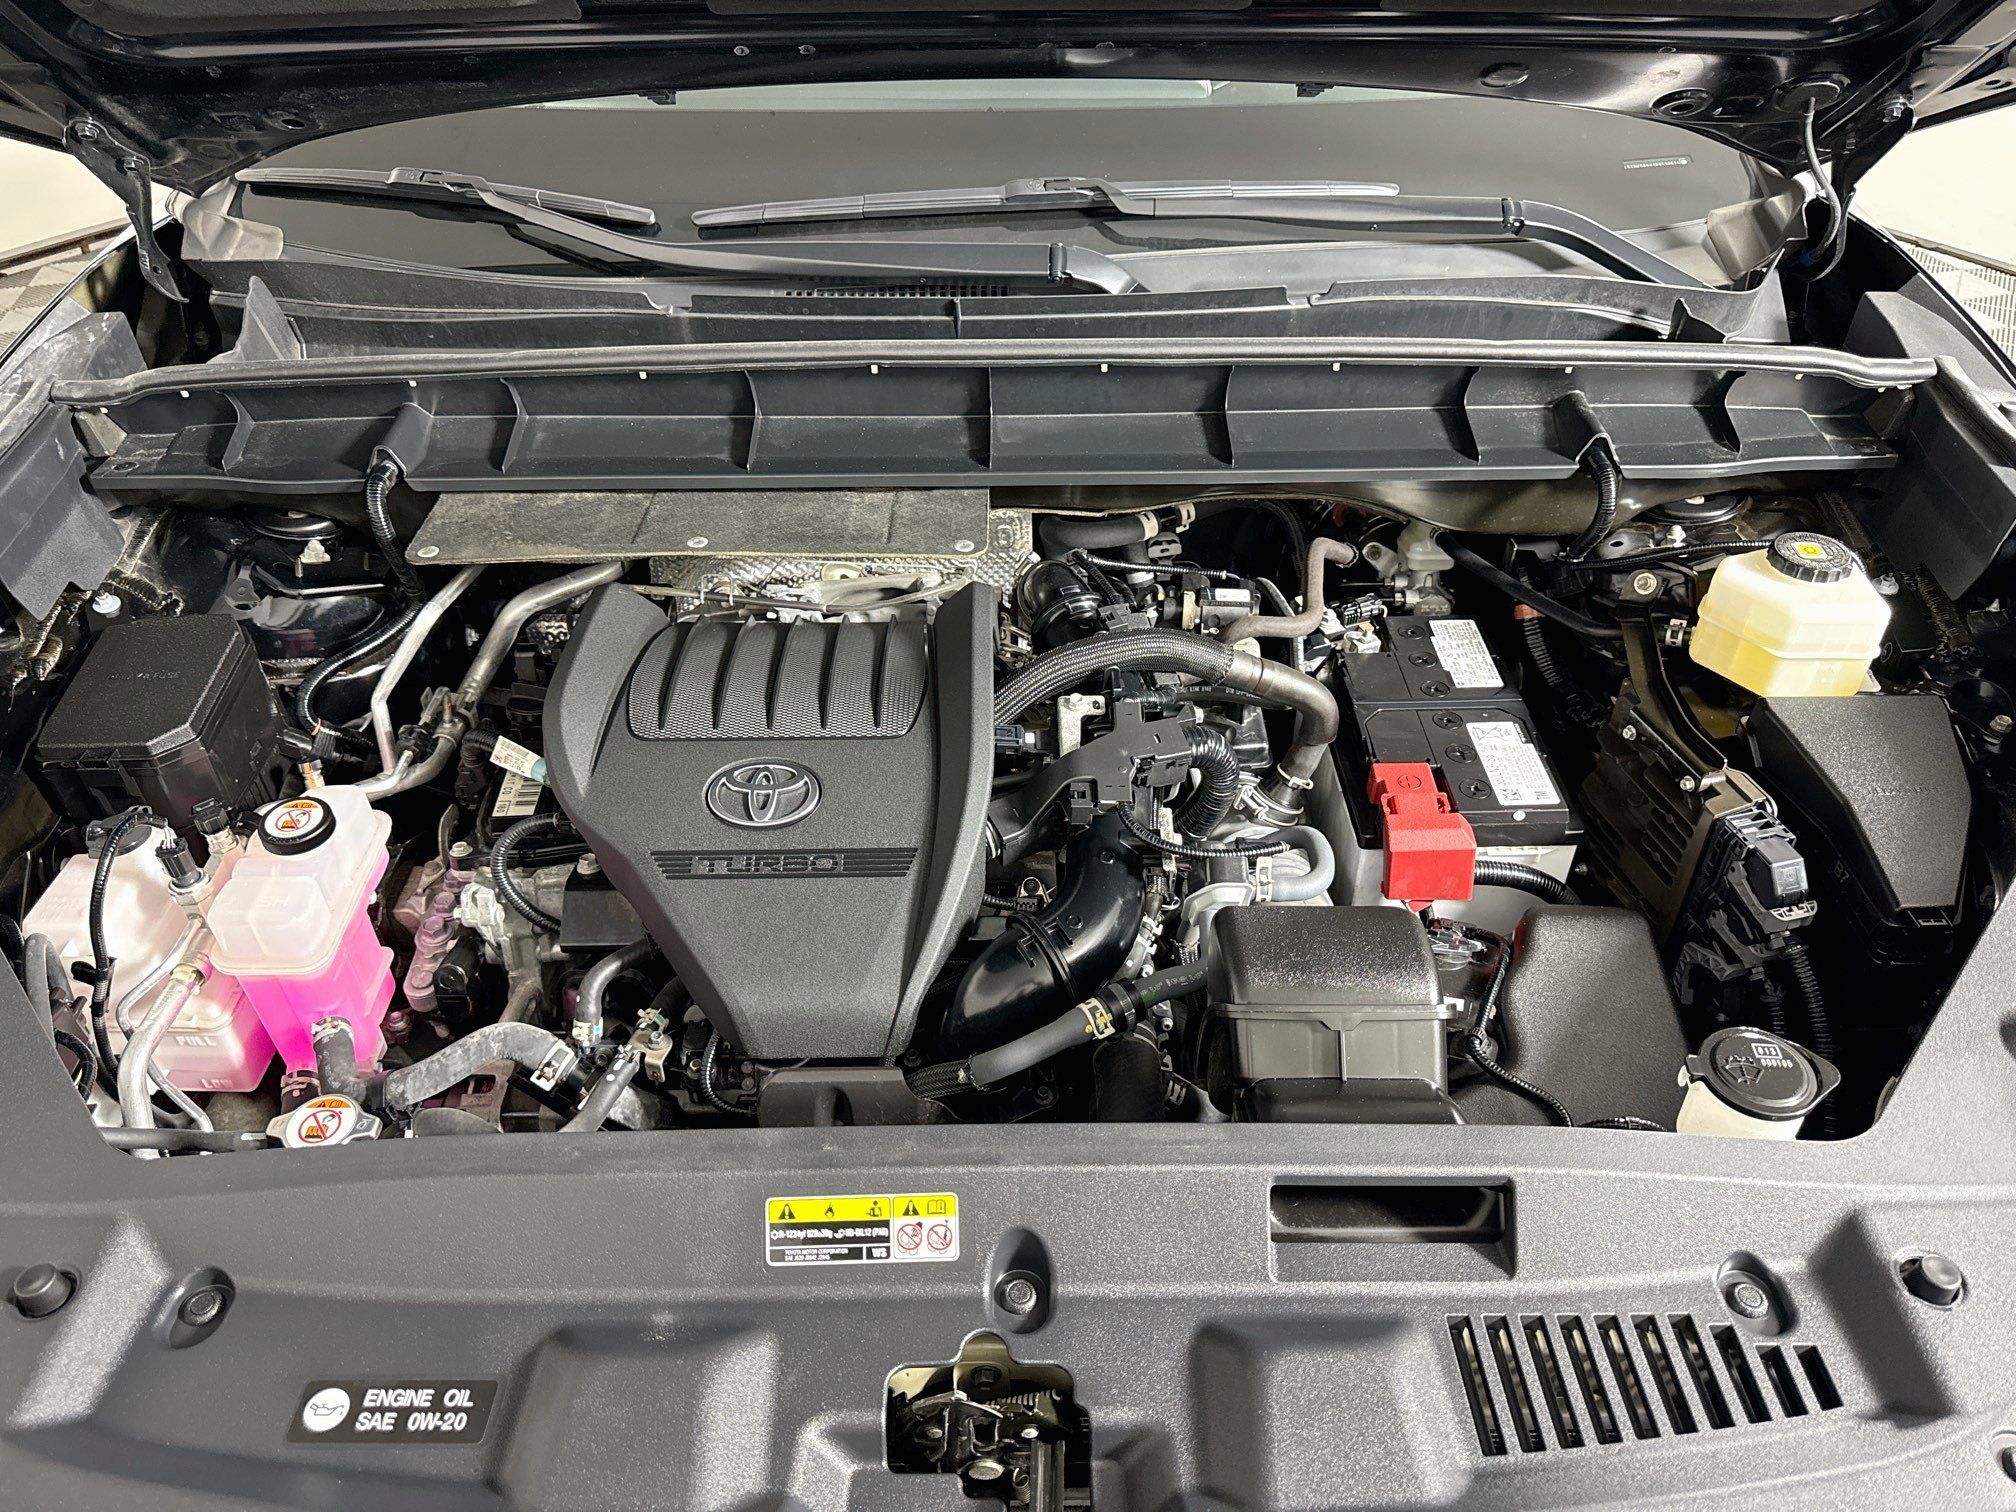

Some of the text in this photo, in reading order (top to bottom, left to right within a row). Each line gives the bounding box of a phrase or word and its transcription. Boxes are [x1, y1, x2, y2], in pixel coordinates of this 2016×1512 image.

[695, 855, 841, 874] TURBO
[175, 1035, 217, 1047] FULL
[362, 1388, 475, 1408] ENGINE OIL
[354, 1412, 468, 1432] SAE 0W-20
